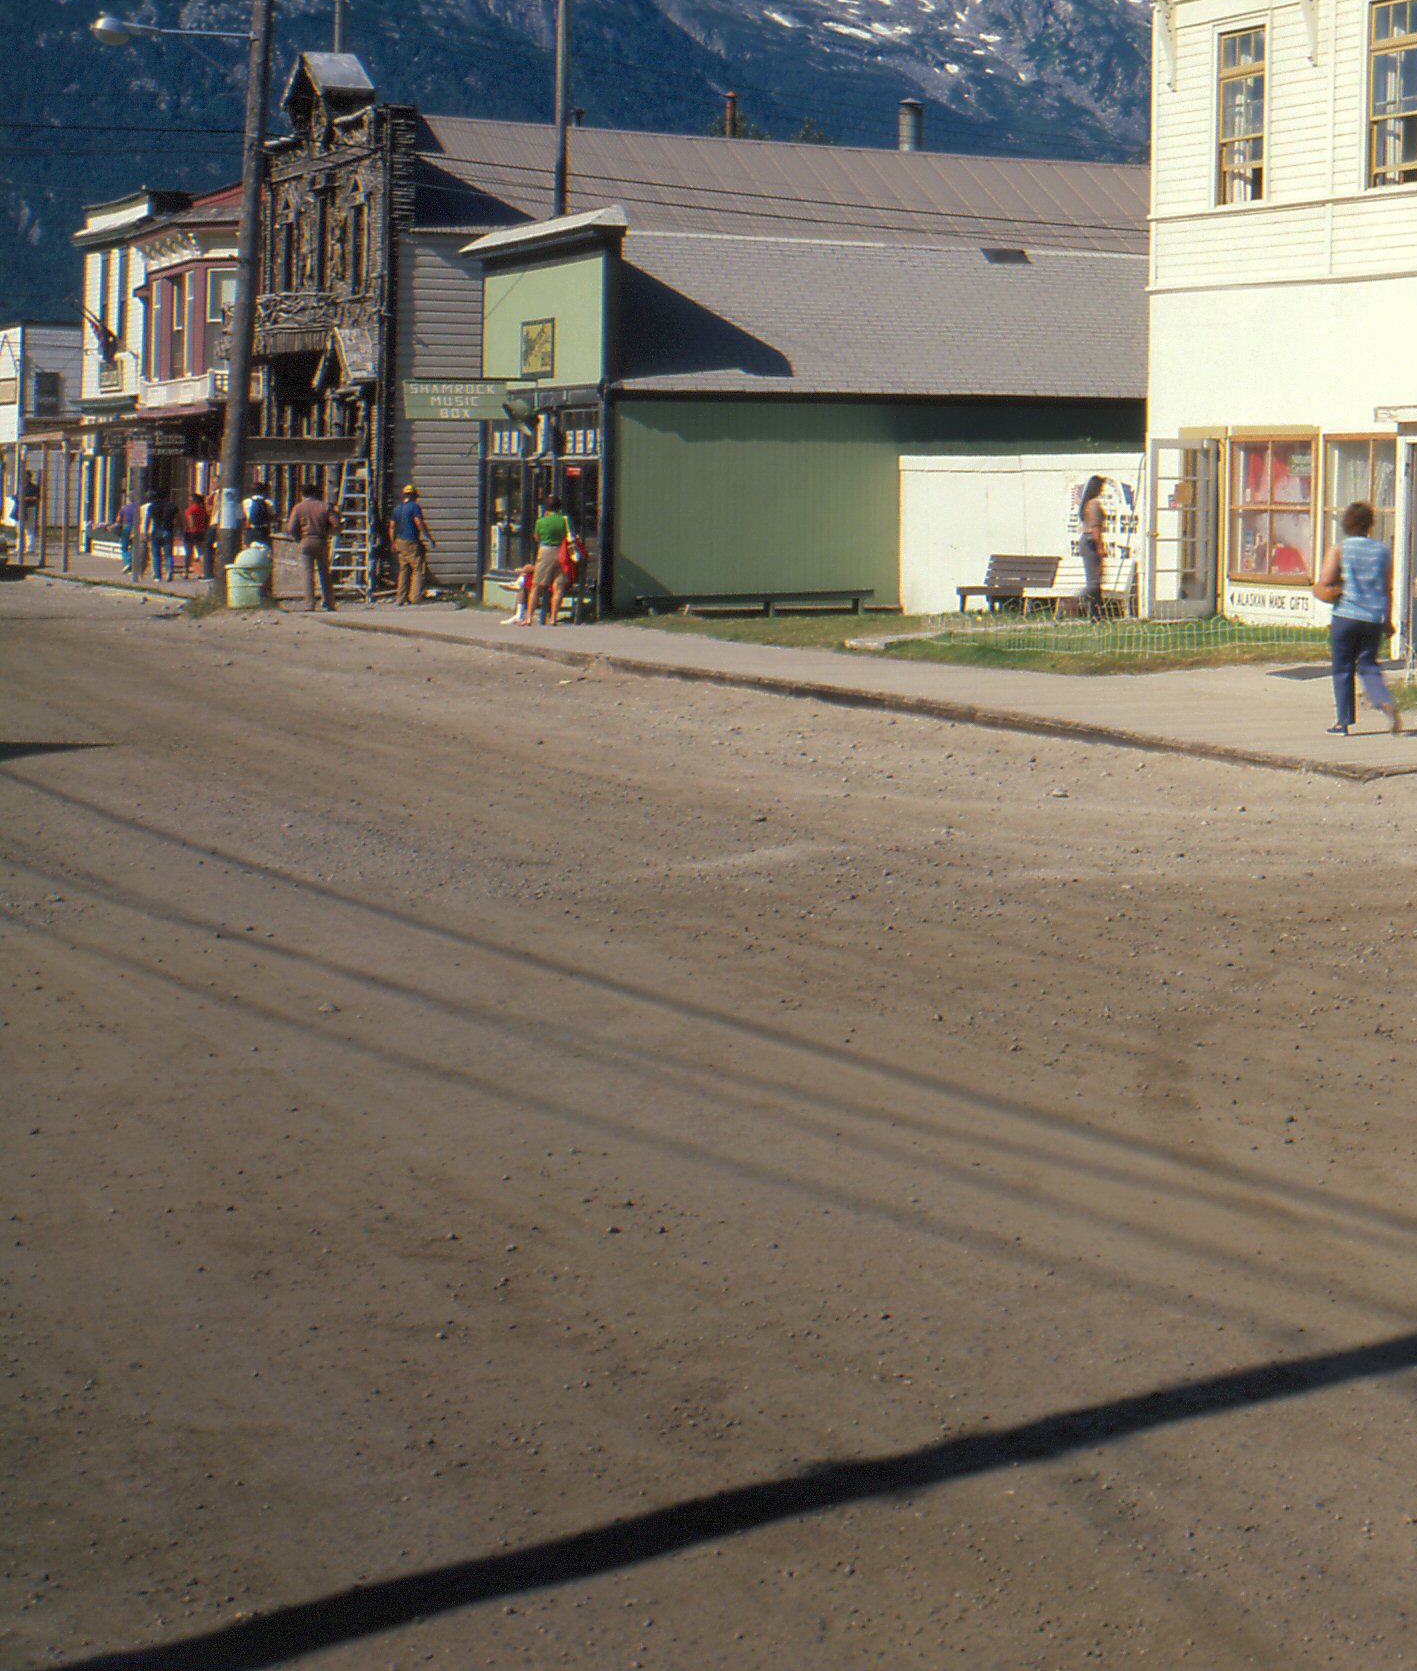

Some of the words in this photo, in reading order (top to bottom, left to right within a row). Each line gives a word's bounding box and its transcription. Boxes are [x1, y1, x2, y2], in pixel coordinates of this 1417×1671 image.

[409, 383, 496, 394] SHAMROCK
[431, 395, 480, 406] MUSIC
[440, 407, 471, 418] BOX
[1237, 593, 1266, 608] ALASKAN
[1269, 594, 1286, 610] MADE
[1290, 596, 1309, 612] GIFTS
